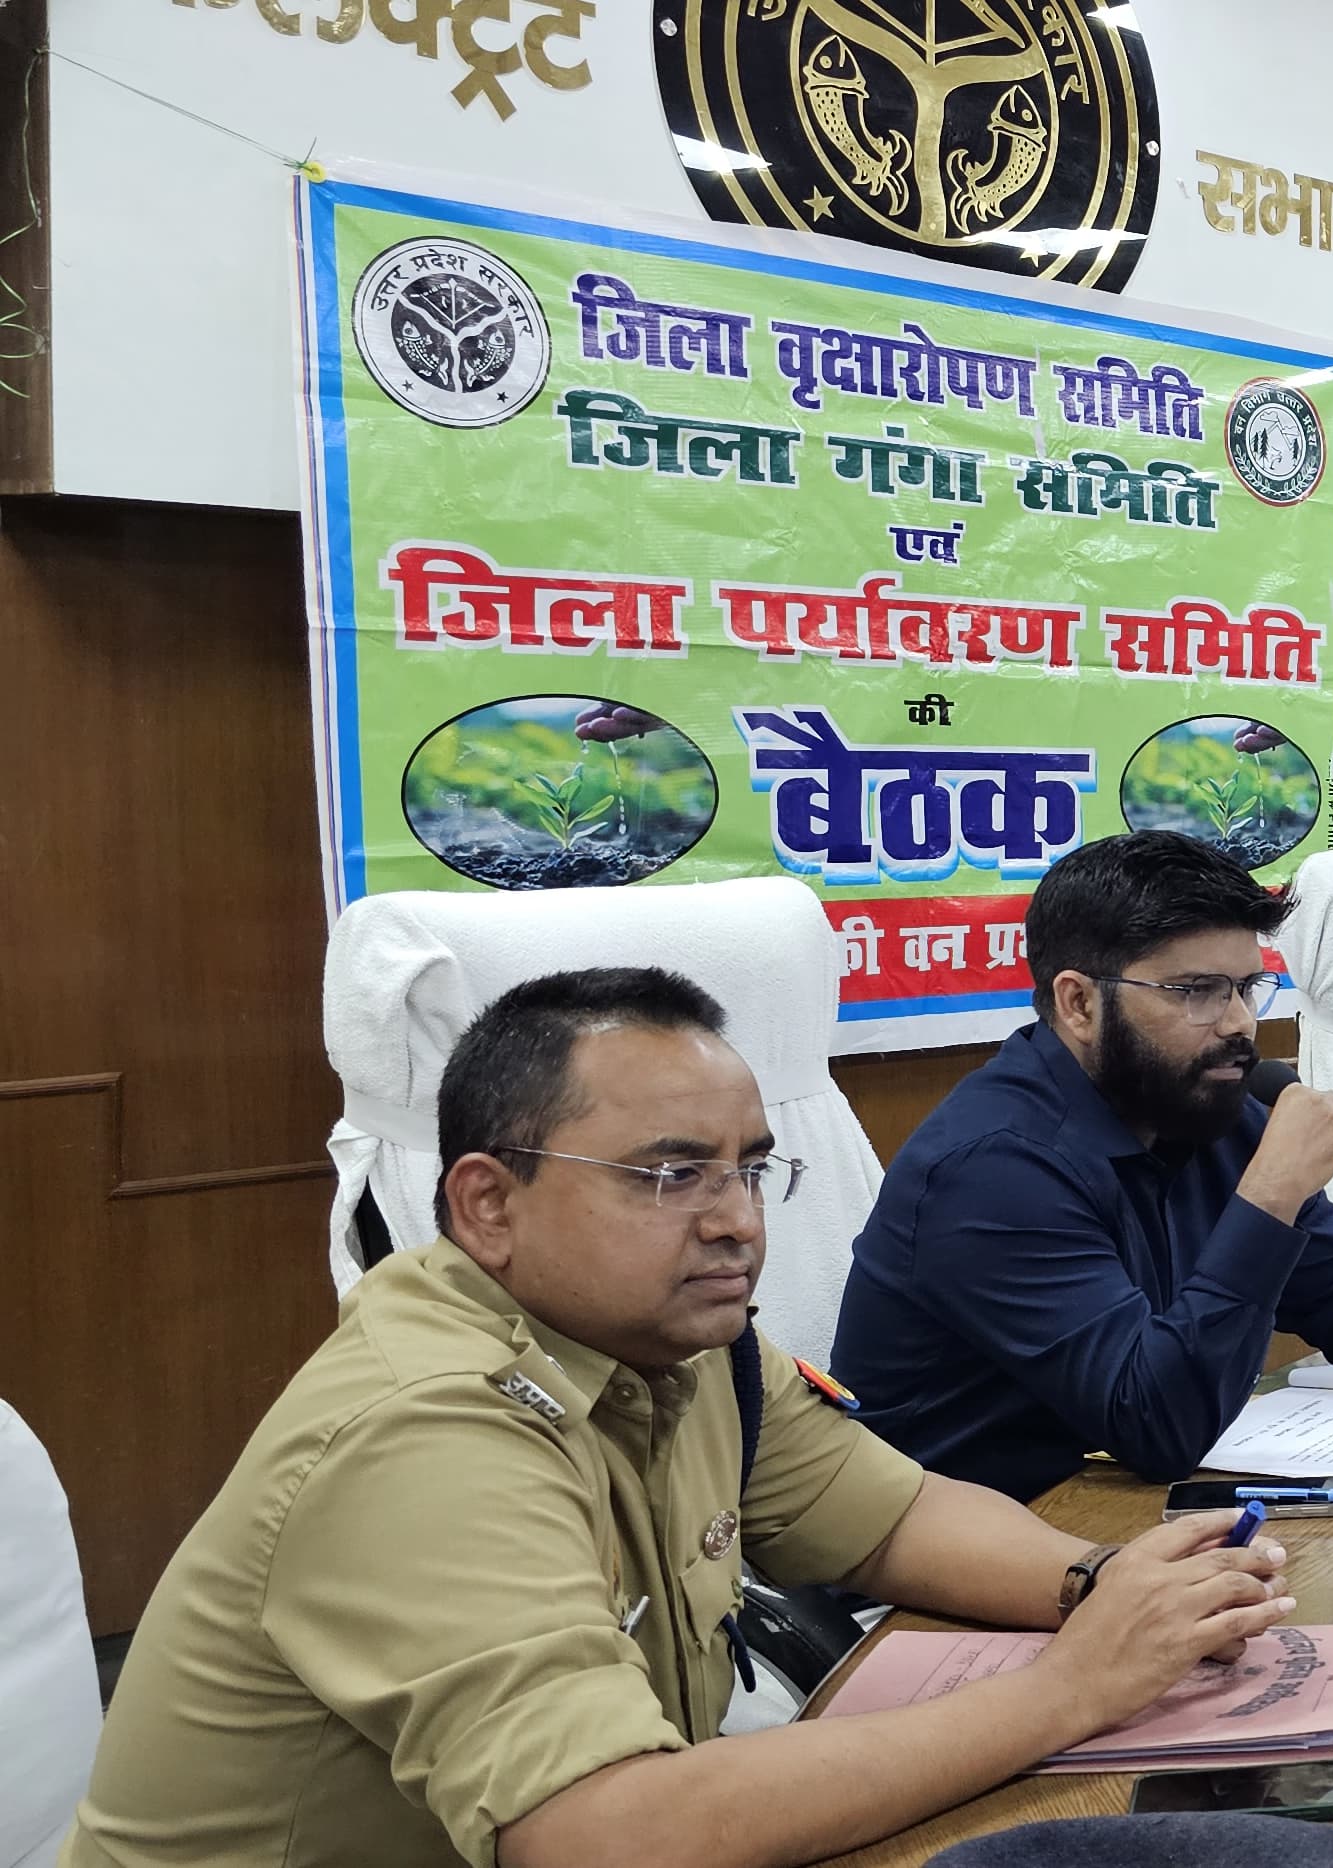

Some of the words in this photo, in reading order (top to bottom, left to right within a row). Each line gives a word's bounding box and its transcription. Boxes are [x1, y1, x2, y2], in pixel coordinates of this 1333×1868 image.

[371, 265, 408, 311] उत्तर
[409, 248, 468, 272] प्रदेश
[478, 264, 535, 338] सरकार
[570, 273, 753, 379] जिला
[769, 322, 1037, 419] वृक्षारोपण
[1052, 355, 1204, 441] समिति
[561, 389, 801, 487] जिला
[826, 424, 986, 504] गंगा
[1014, 451, 1222, 530] समिति
[889, 524, 964, 565] एवं
[387, 546, 688, 652] जिला
[717, 576, 1082, 670] पर्यावरण
[1104, 600, 1323, 684] समिति
[903, 693, 955, 726] की
[742, 709, 1092, 866] बैठक
[899, 924, 971, 972] वन
